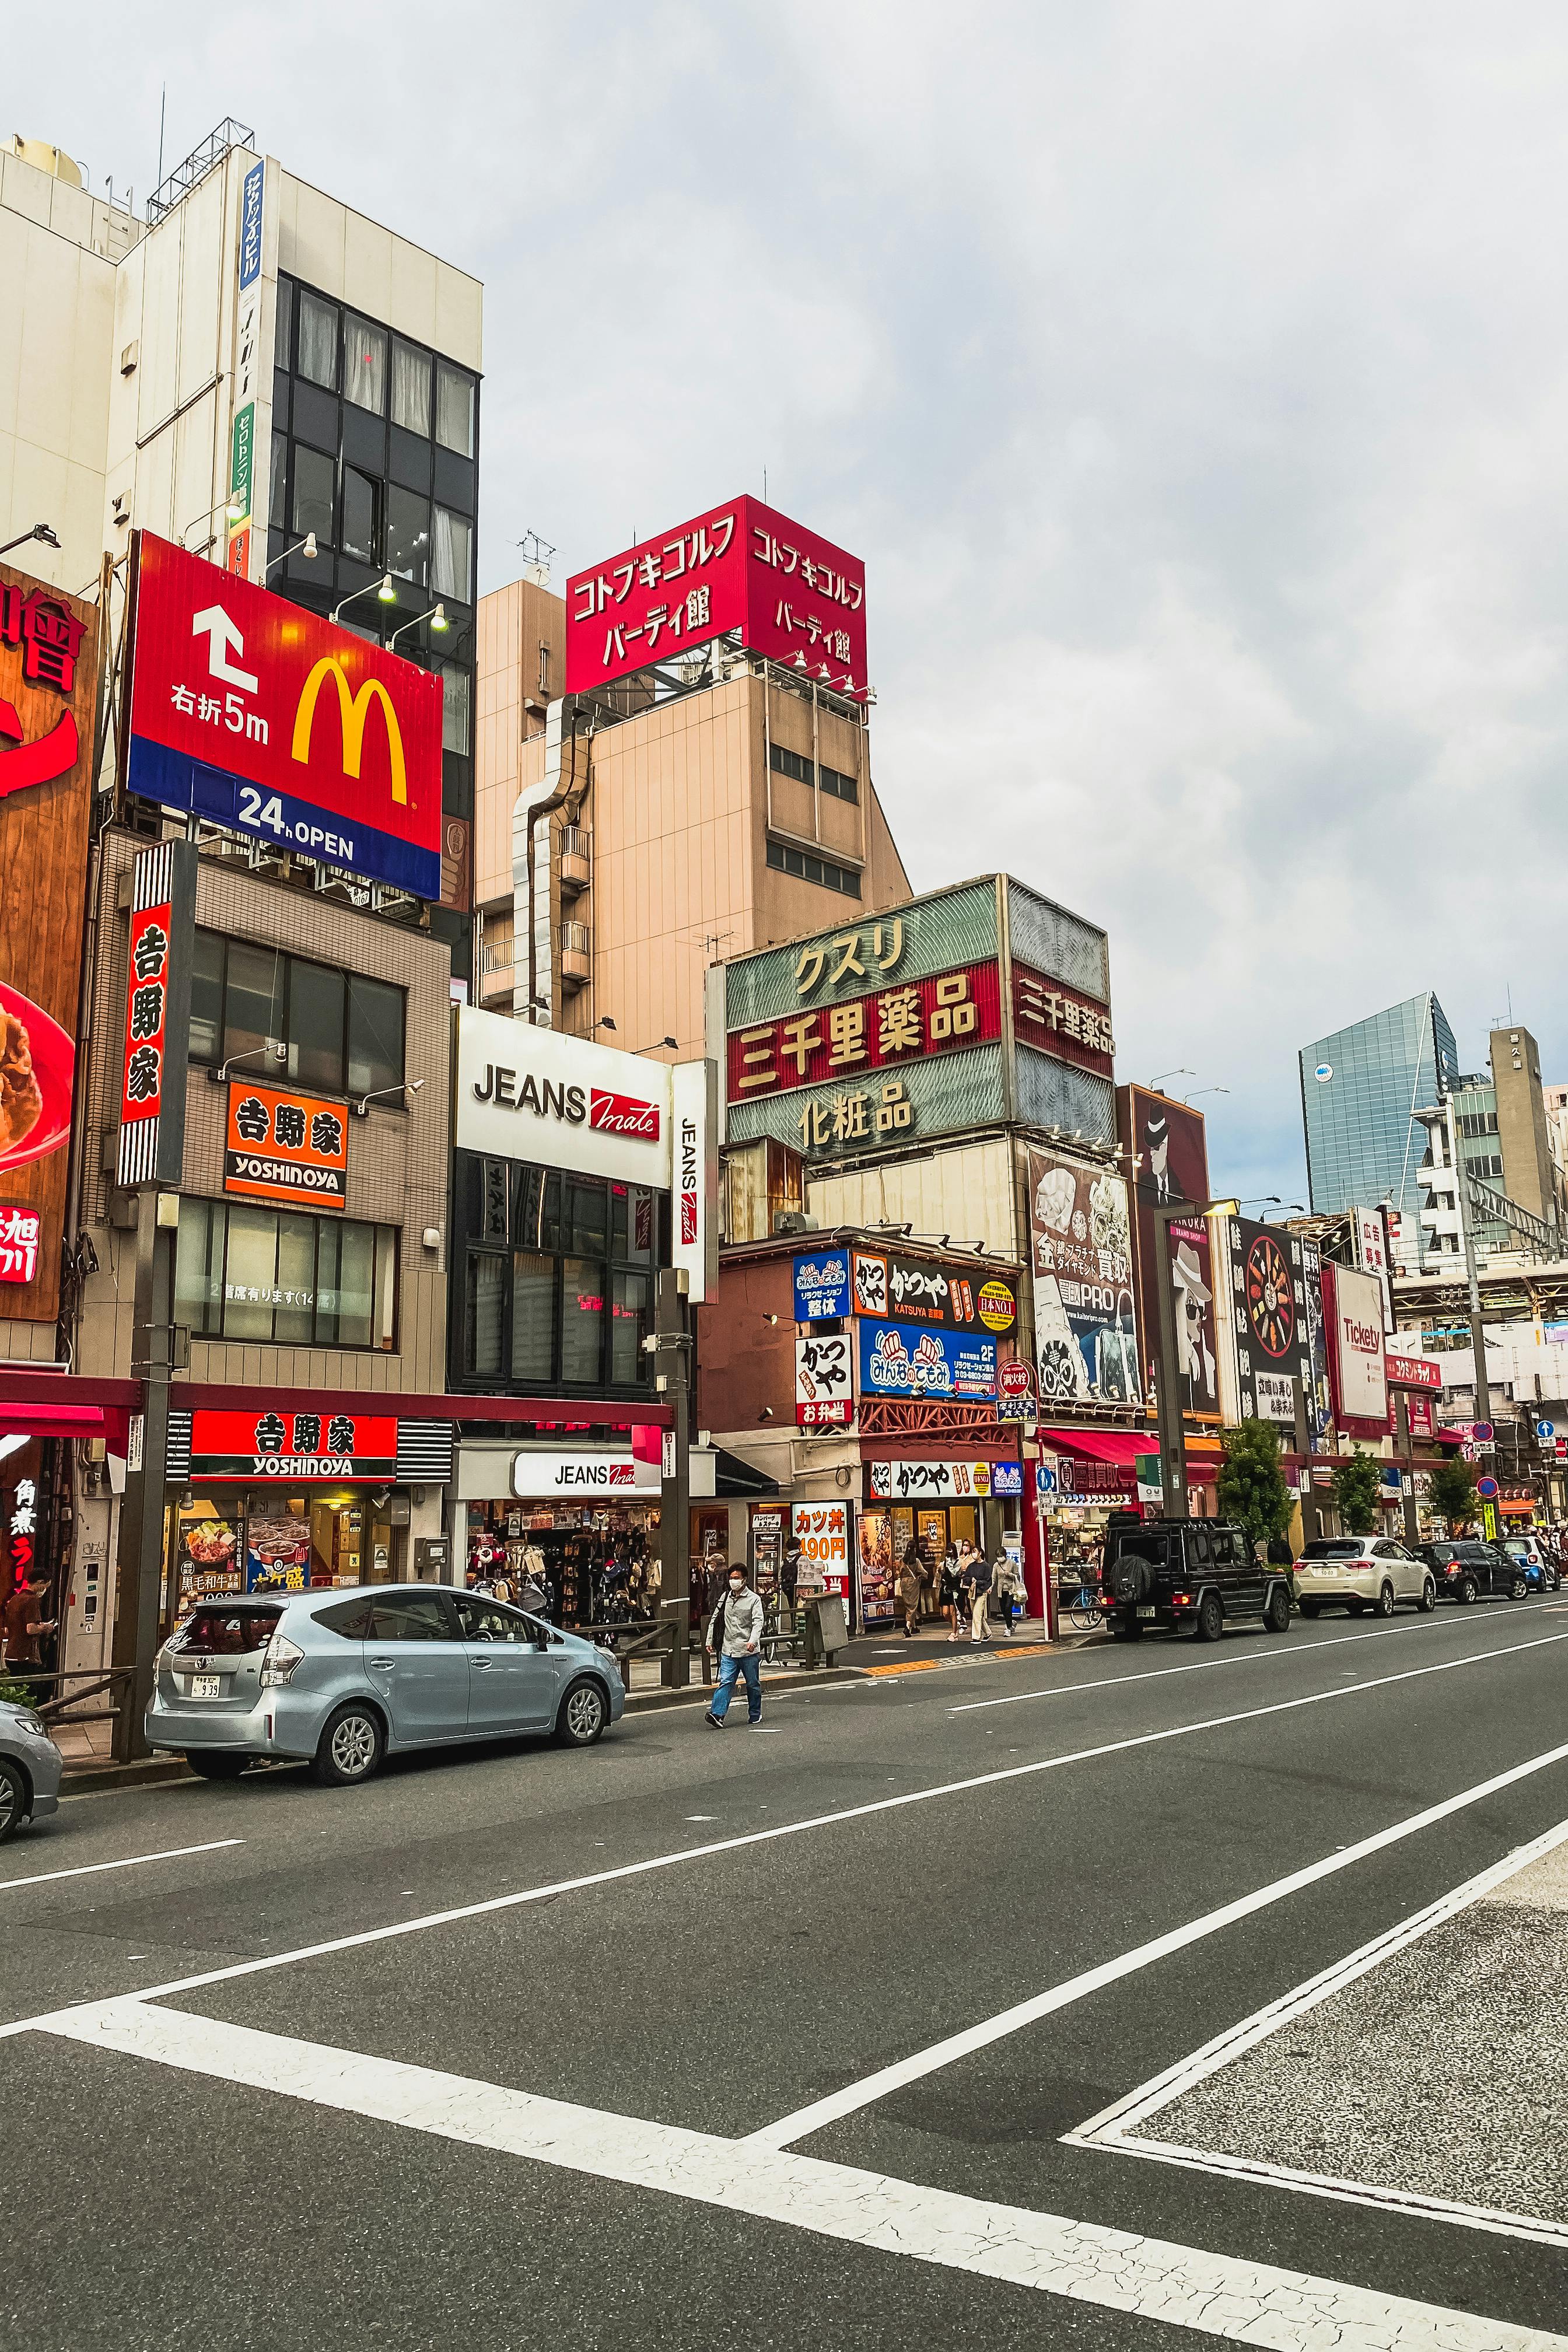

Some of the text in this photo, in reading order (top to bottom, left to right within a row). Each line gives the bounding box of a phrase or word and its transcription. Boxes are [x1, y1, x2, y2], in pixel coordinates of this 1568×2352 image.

[575, 514, 734, 621] コトブキゴルフ
[754, 526, 863, 609] コトブキゴルフ
[603, 584, 710, 666] バーディ館
[776, 599, 851, 665] バーディ館
[170, 684, 270, 746] 右折5m
[295, 820, 354, 861] OPEN
[795, 919, 903, 995] クスリ
[128, 925, 169, 1103] 吉野家
[738, 974, 978, 1088] 三千里薬品
[1019, 978, 1115, 1057] 三千里薬品
[473, 1064, 660, 1133] JEANS mate
[797, 1081, 911, 1148] 化粧品
[235, 1097, 343, 1156] 吉野家
[235, 1156, 340, 1191] YOSHINOYA
[681, 1118, 697, 1244] JEANS mate
[1036, 1231, 1056, 1270] 金
[1363, 1222, 1380, 1242] 広告
[1057, 1256, 1097, 1278] ダイヤモンド
[1365, 1247, 1382, 1267] 募集
[802, 1288, 842, 1300] リラクゼーション
[889, 1264, 948, 1308] かつや
[807, 1298, 836, 1317] 整体
[894, 1303, 927, 1318] KATSUYA
[981, 1345, 994, 1362] 2F
[1343, 1317, 1380, 1354] Tickety
[874, 1359, 949, 1385] みんなのてもみ
[1003, 1372, 1027, 1386] 消火栓
[803, 1401, 845, 1422] お弁当
[255, 1412, 355, 1454] 吉野家
[253, 1457, 353, 1475] YOSHINOYA
[555, 1465, 607, 1485] JEANS
[896, 1462, 950, 1497] かつや
[1096, 1462, 1119, 1488] 買取
[795, 1508, 845, 1534] カツ丼
[181, 1574, 228, 1591] 黒毛和牛
